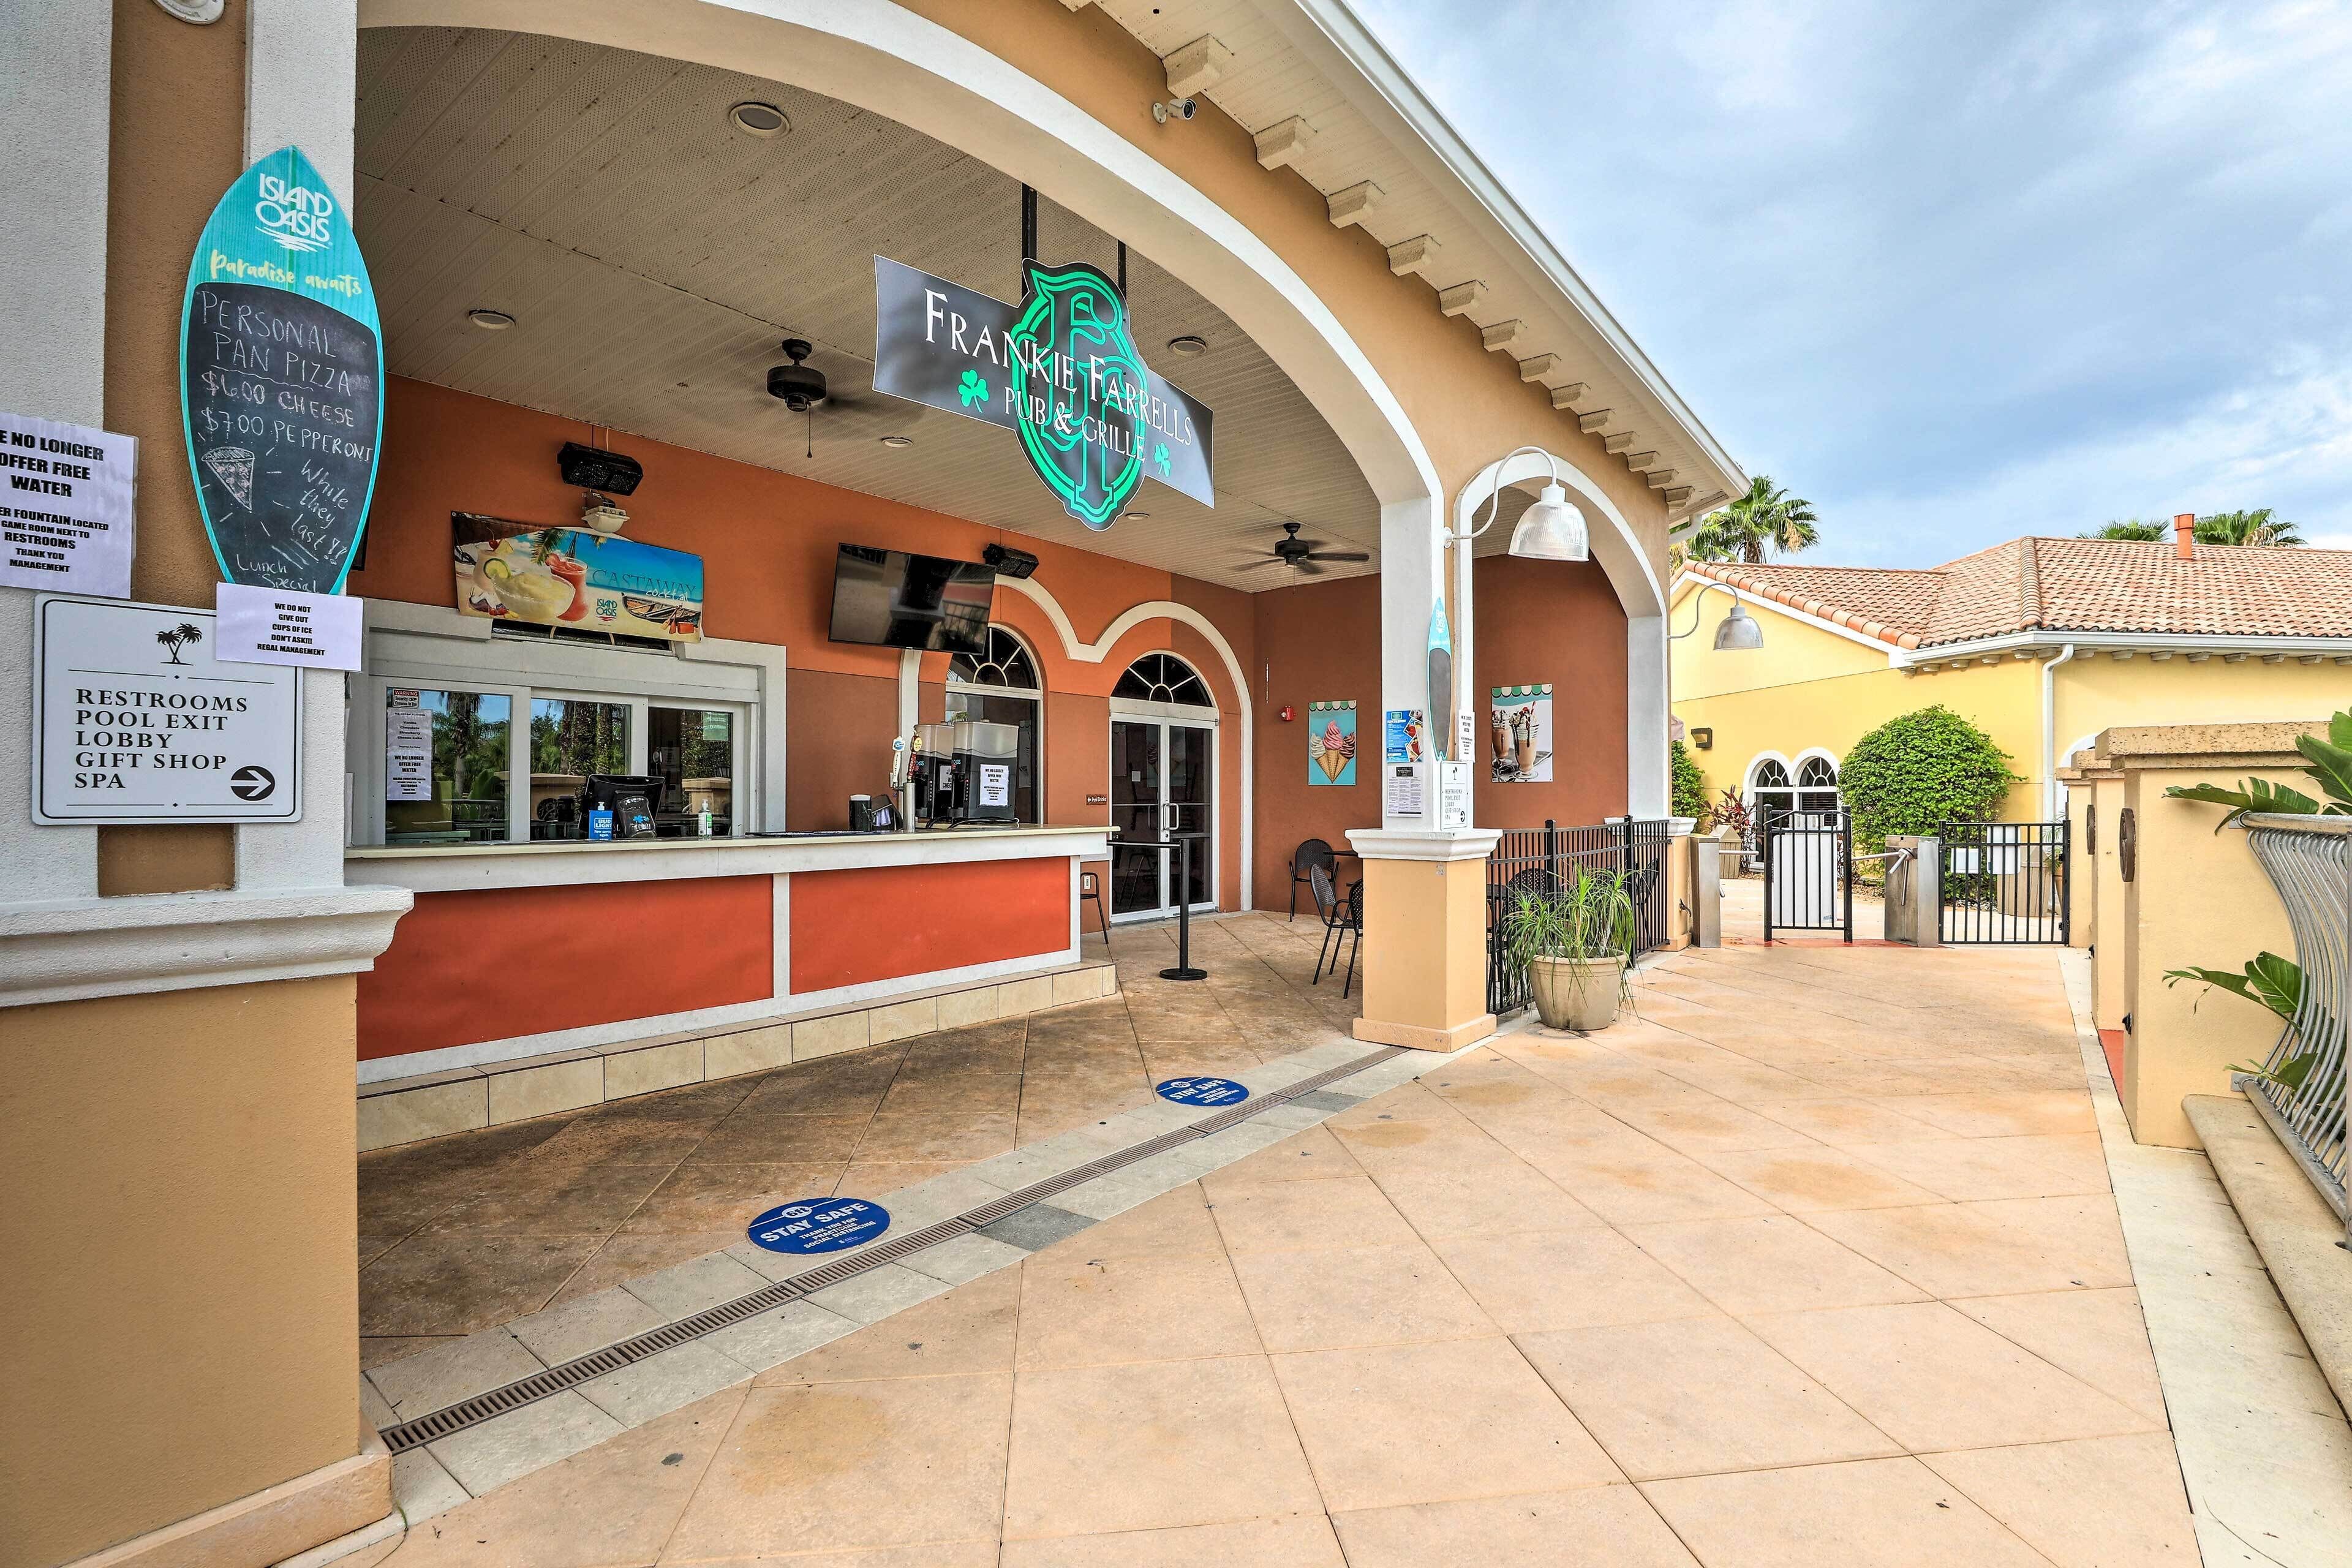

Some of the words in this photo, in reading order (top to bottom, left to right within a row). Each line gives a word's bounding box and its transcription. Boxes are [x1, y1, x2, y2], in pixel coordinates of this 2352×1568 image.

[259, 173, 333, 217] ISLAND
[255, 201, 330, 242] OASIS
[210, 249, 295, 283] Paradise
[305, 274, 363, 298] awaits
[202, 291, 336, 358] PERSONAL
[214, 332, 270, 371] PAN
[286, 352, 351, 396] PIZZA
[924, 288, 1077, 394] FRANKIE
[1088, 353, 1192, 447] FARRELLS
[279, 391, 354, 427] CHEESE
[1005, 386, 1046, 426] PUB
[1055, 401, 1072, 434] &
[1082, 417, 1145, 464] GRILLE
[11, 431, 36, 449] NO
[40, 437, 104, 461] LONGER
[274, 421, 372, 461] PEPPERONI
[0, 453, 48, 474] OFFER
[52, 461, 91, 481] FREE
[10, 475, 72, 497] WATER
[301, 459, 348, 509] While
[14, 508, 71, 526] FOUNTAIN
[72, 519, 109, 531] LOCATED
[300, 489, 335, 529] they
[1, 521, 27, 530] GAME
[28, 524, 55, 534] ROOM
[56, 527, 77, 537] NEXT
[78, 530, 90, 539] TO
[4, 531, 76, 549] RESTROOMS
[292, 514, 326, 550] last
[15, 548, 45, 559] THANK
[47, 551, 65, 560] YOU
[236, 554, 287, 574] Lunch
[9, 559, 70, 573] MANAGEMENT
[262, 573, 320, 593] Special
[592, 569, 697, 596] CASTAWAY
[597, 598, 617, 608] ISLAND
[646, 588, 689, 601] cocktail
[596, 607, 617, 616] OASIS
[280, 646, 325, 656] MANAGEMENT
[76, 688, 247, 712] RESTROOMS
[76, 710, 155, 728] POOL
[166, 714, 228, 731] EXIT
[76, 731, 173, 748] LOBBY
[76, 752, 143, 769] GIFT
[153, 753, 227, 770] SHOP
[74, 773, 126, 789] SPA
[1169, 1087, 1199, 1099] STAY
[1196, 1079, 1227, 1090] SAFE
[760, 1219, 813, 1242] STAY
[814, 1203, 869, 1223] SAFE
[786, 1207, 810, 1217] 6ft
[799, 1227, 827, 1239] THANK
[804, 1237, 834, 1248] SOCIAL
[832, 1221, 876, 1238] DISTANCING
